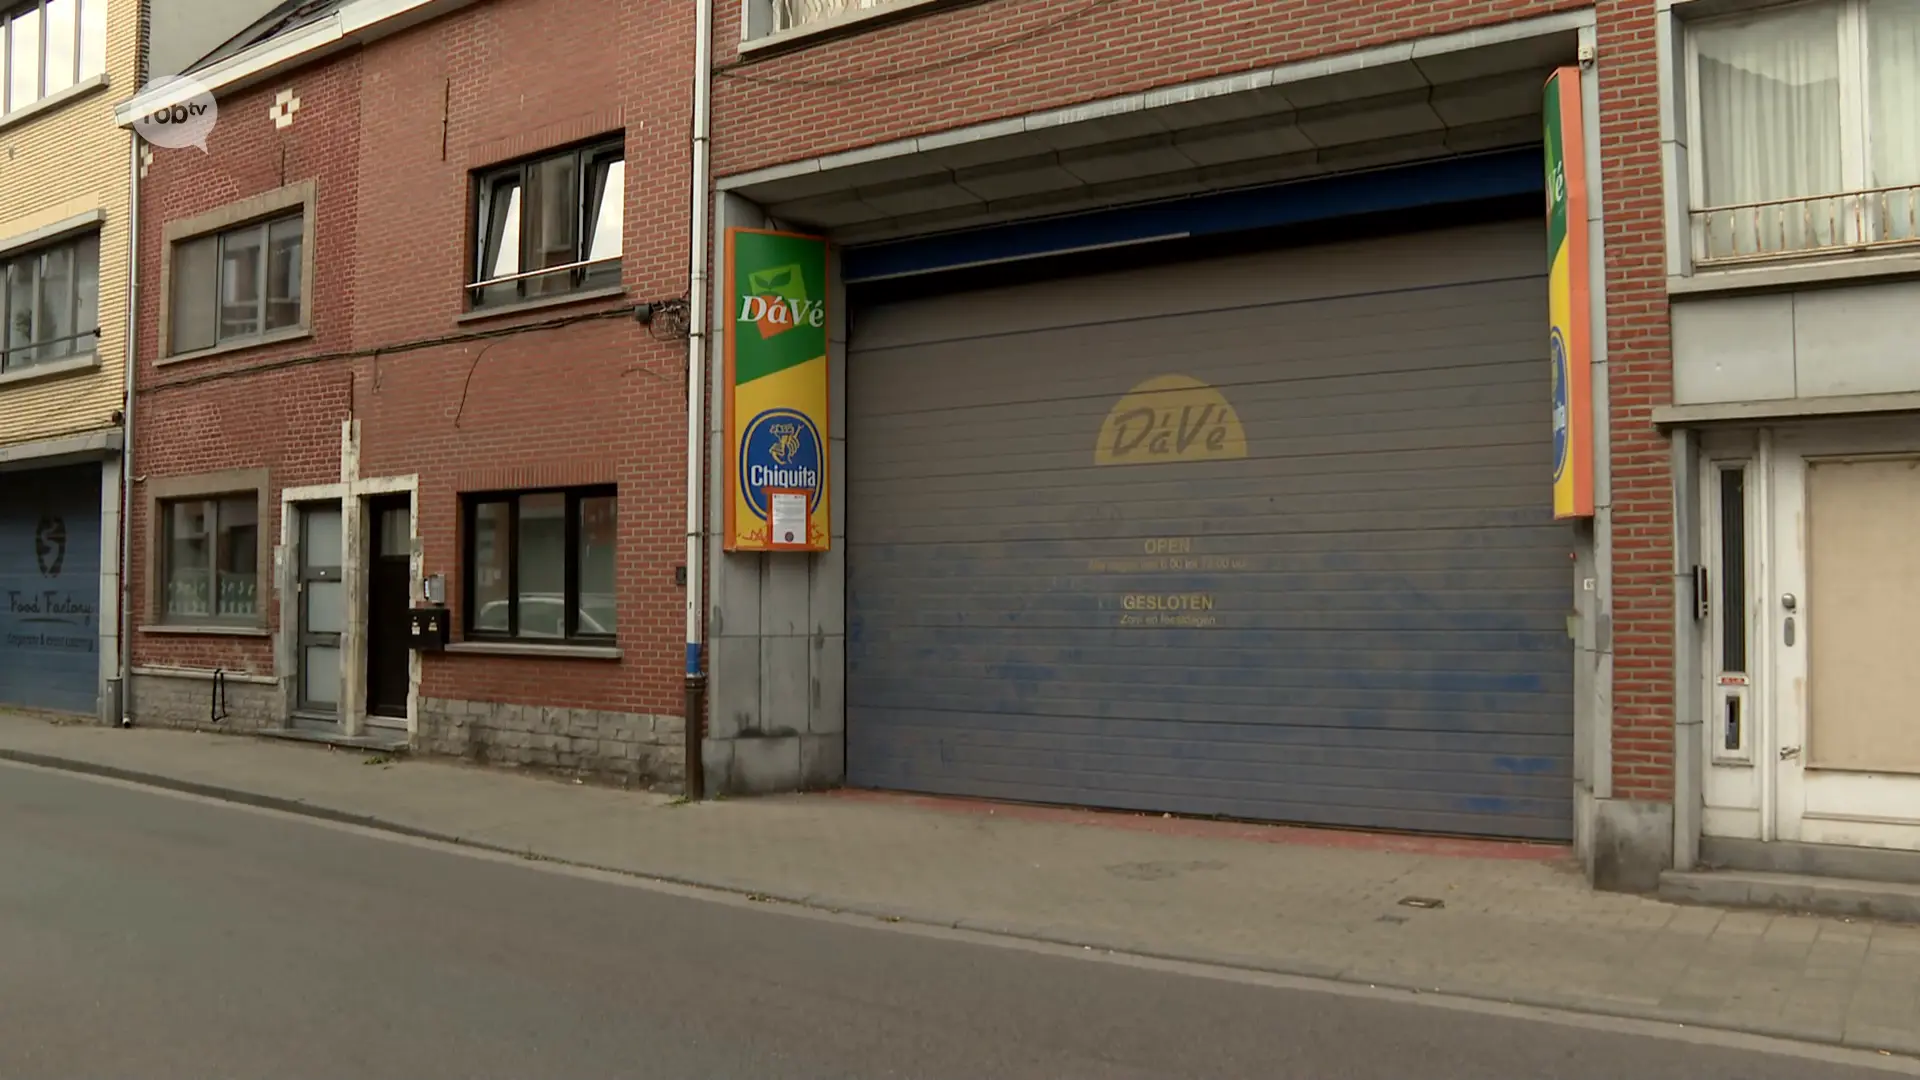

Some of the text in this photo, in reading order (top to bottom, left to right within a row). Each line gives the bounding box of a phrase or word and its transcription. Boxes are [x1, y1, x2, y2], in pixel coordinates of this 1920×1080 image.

[737, 295, 824, 328] DáVé
[750, 465, 816, 488] Chiquita
[1144, 538, 1191, 554] OPEN
[8, 591, 93, 626] Food Factory
[1123, 594, 1214, 610] GESLOTEN
